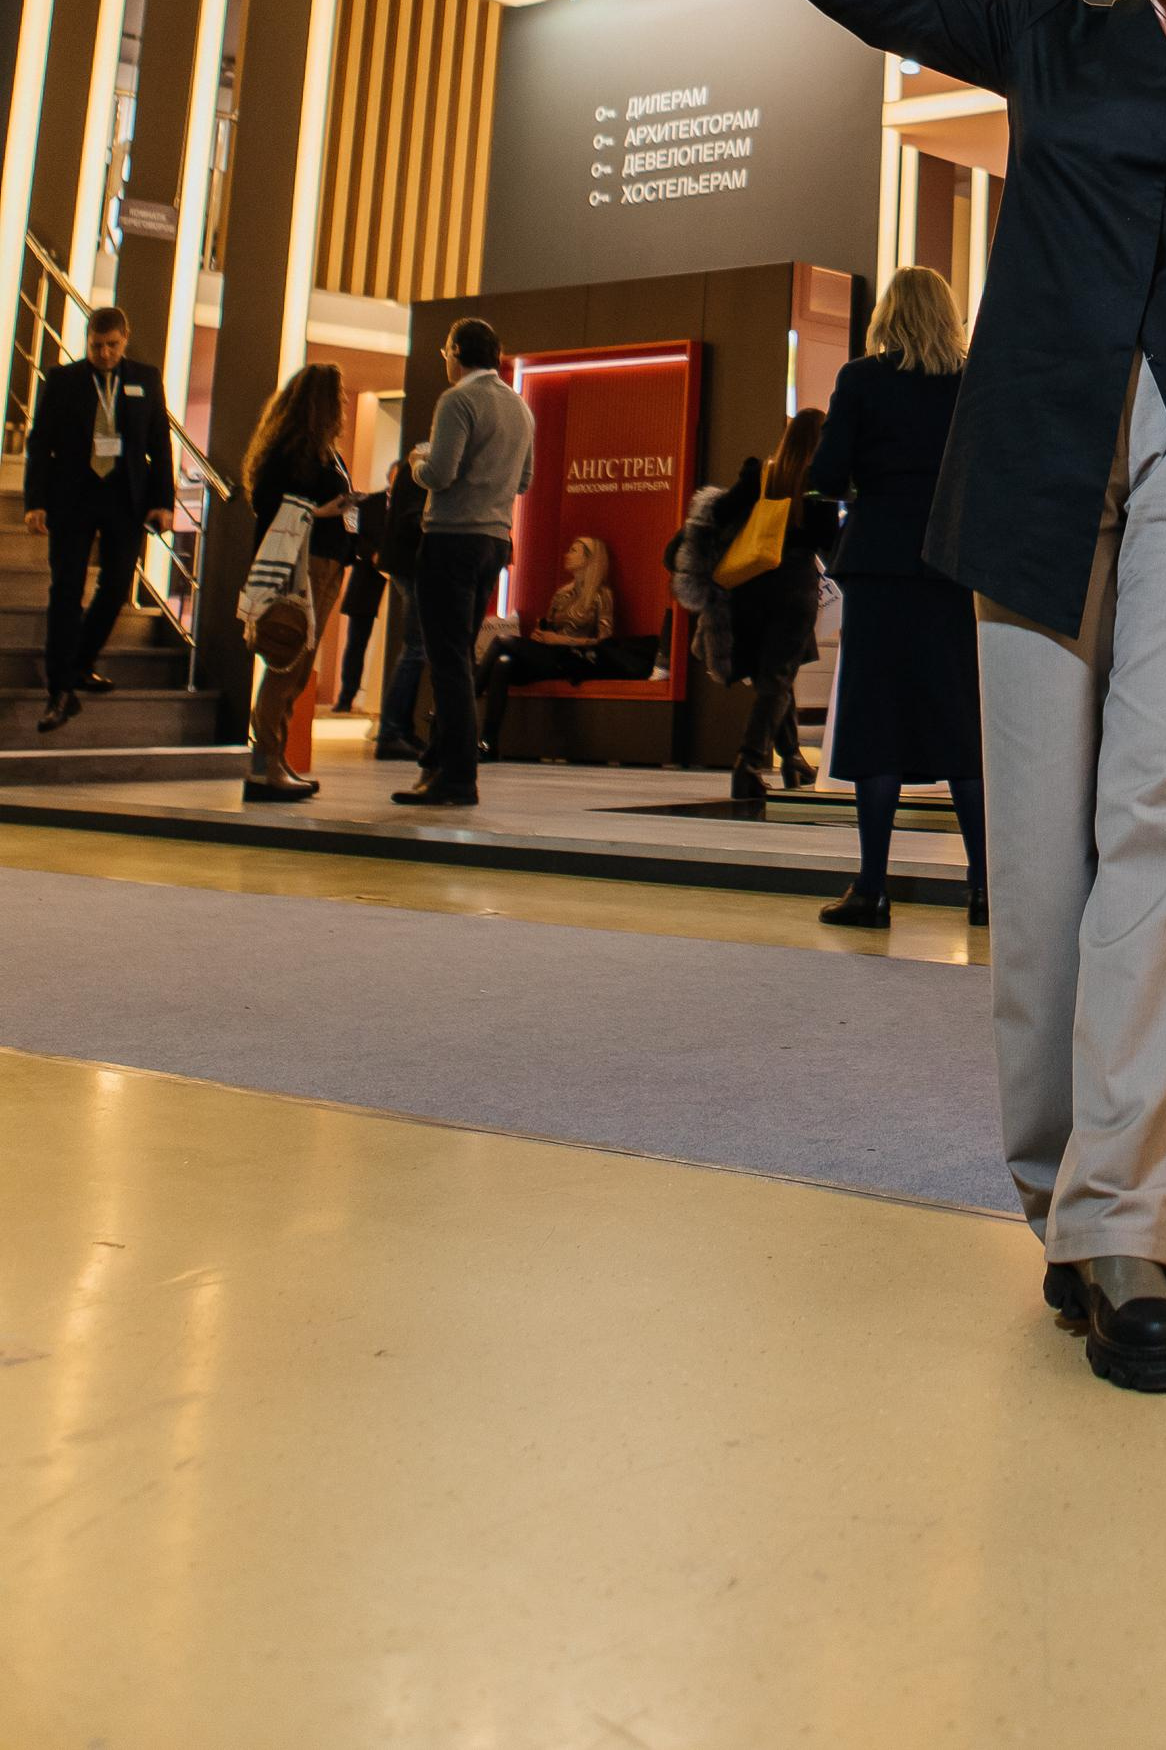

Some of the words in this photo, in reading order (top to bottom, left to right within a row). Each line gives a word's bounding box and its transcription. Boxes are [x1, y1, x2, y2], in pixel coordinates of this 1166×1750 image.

[626, 86, 708, 121] ДИЛЕРАМ
[624, 108, 759, 148] АРХИТЕКТОРАМ
[622, 137, 751, 178] ДЕВЕЛОПЕРАМ
[620, 168, 748, 204] ХОСТЕЛЬЕРАМ
[567, 456, 673, 480] АНГСТРЕМ
